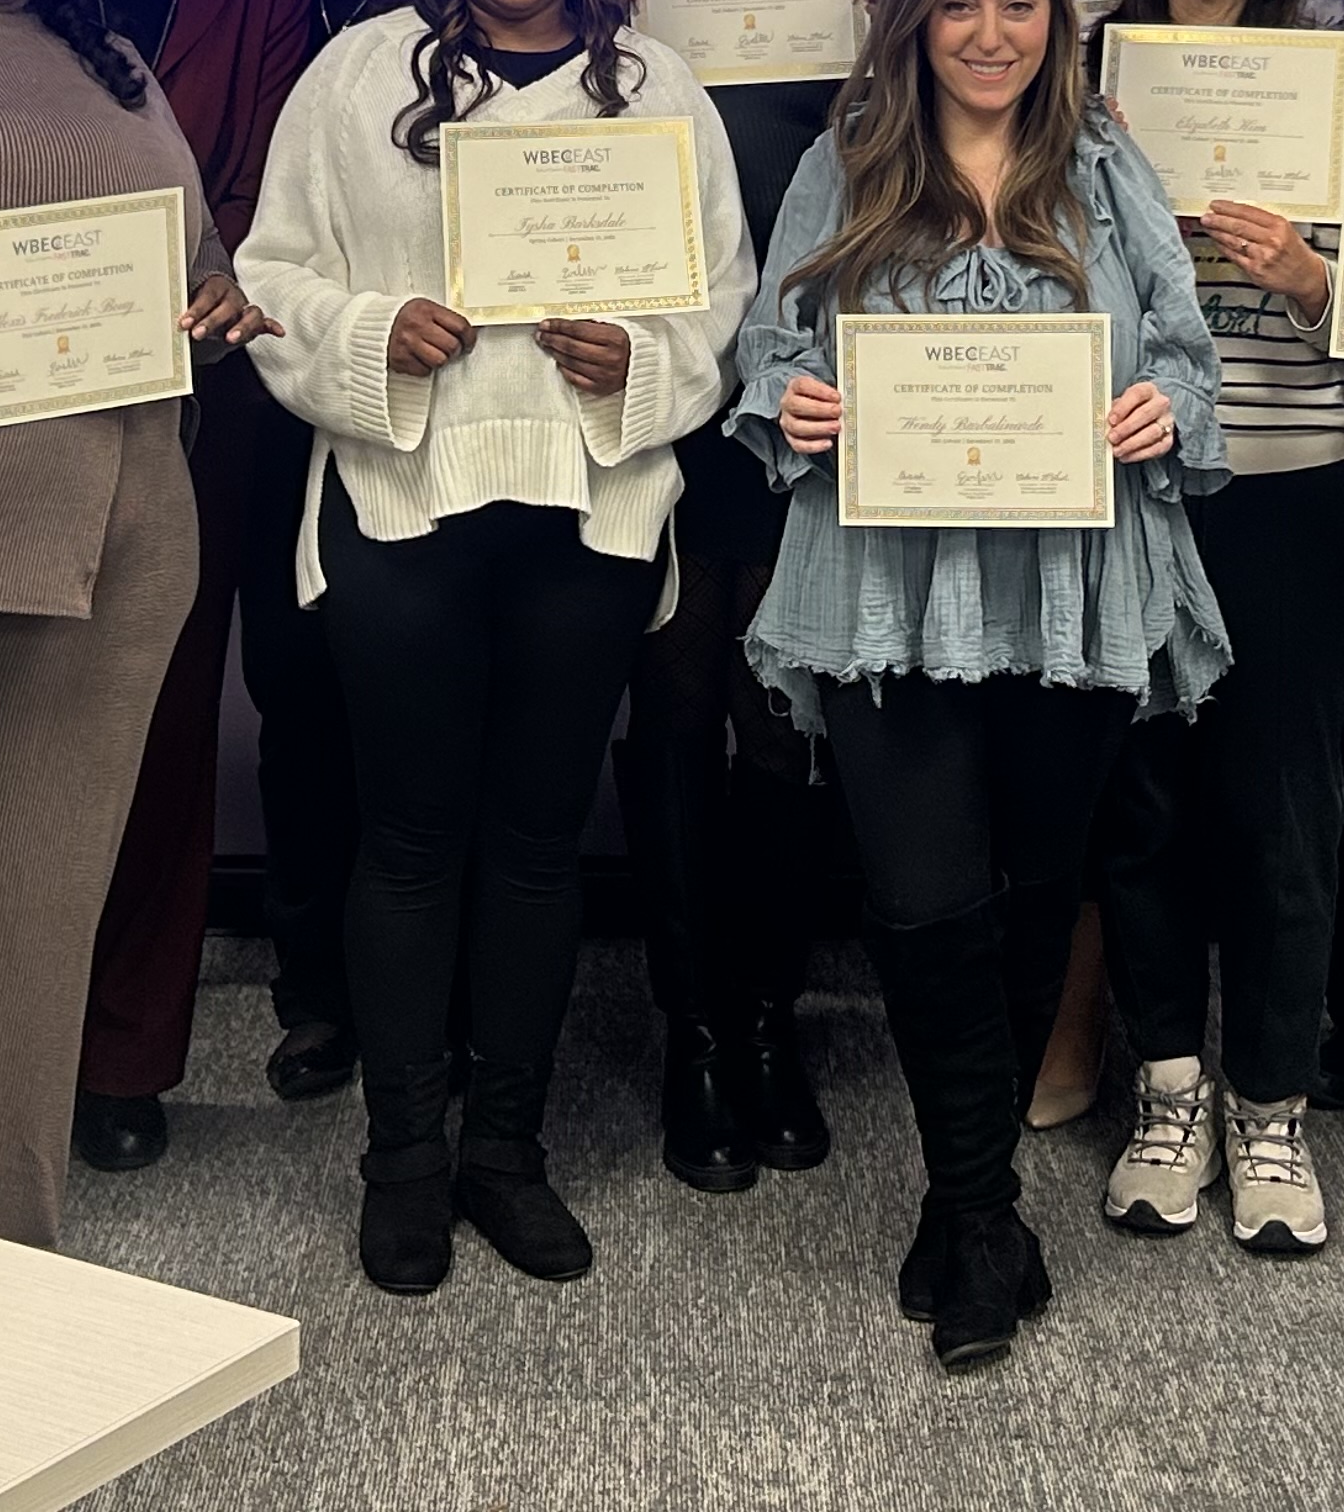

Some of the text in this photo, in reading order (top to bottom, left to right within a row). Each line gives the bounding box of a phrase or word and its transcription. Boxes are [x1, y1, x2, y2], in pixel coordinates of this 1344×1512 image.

[1150, 86, 1298, 100] CERTIFICATE OF COMPLETION
[494, 182, 644, 196] CERTIFICATE OF COMPLETION
[52, 273, 65, 284] OF
[68, 263, 134, 280] COMPLETION
[893, 384, 1053, 393] CERTIFICATE OF COMPLETION
[897, 415, 947, 441] Wendy
